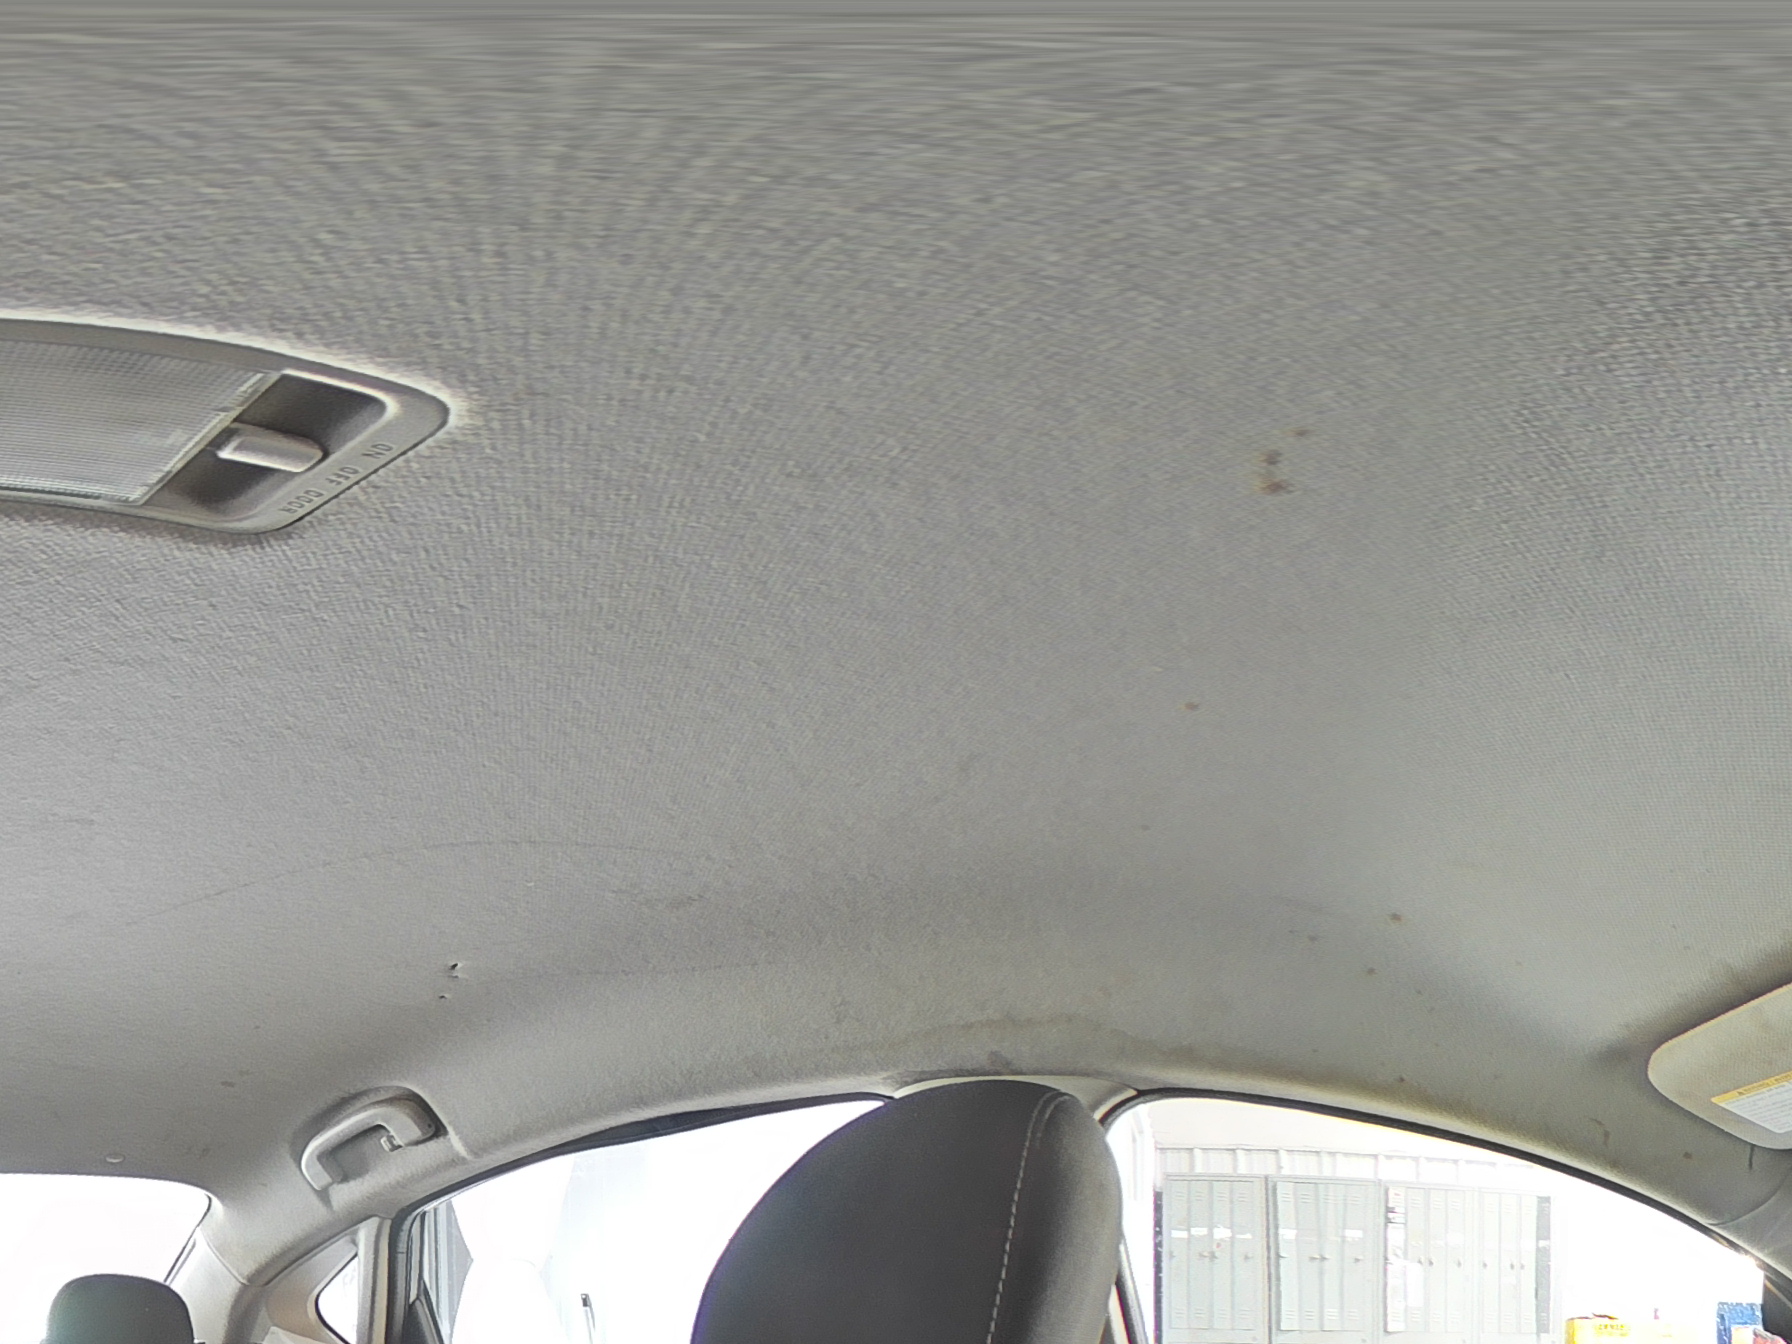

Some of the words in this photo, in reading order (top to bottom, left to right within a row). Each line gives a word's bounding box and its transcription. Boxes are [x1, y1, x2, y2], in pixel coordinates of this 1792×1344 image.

[361, 443, 394, 459] ON
[325, 466, 360, 486] OFF
[280, 489, 324, 514] DOOR
